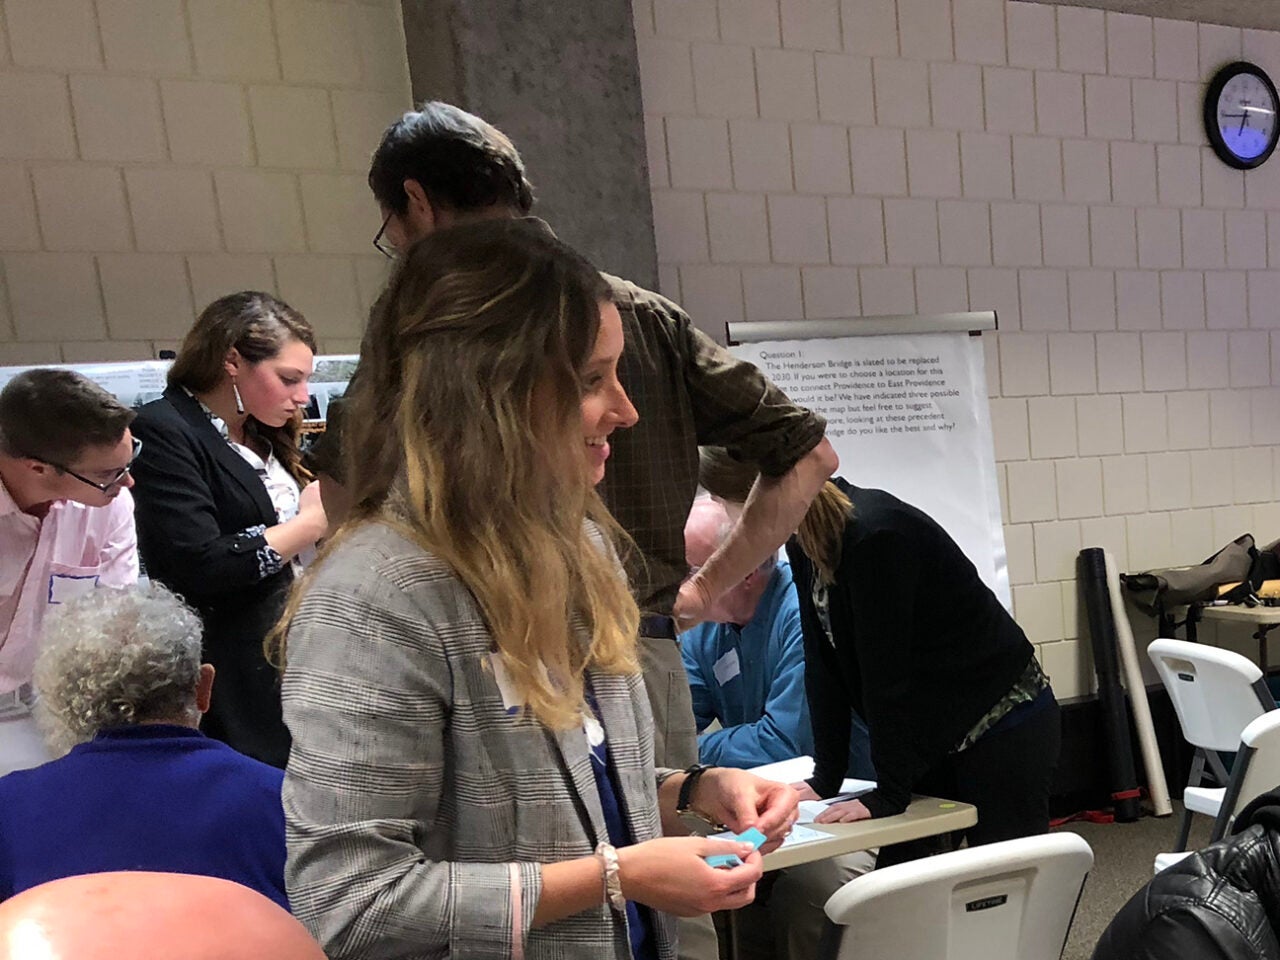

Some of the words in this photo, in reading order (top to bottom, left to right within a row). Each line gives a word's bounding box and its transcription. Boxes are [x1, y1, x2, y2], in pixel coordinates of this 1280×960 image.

[759, 350, 796, 360] Question
[766, 362, 781, 370] The
[783, 361, 826, 370] Henderson
[828, 359, 852, 369] Bridge
[854, 358, 861, 367] is
[862, 357, 885, 366] slated
[886, 357, 895, 366] to
[897, 356, 907, 365] be
[908, 354, 940, 365] replaced
[794, 372, 799, 380] If
[801, 374, 816, 382] you
[849, 370, 877, 378] choose
[885, 368, 915, 377] location
[917, 367, 928, 375] for
[929, 367, 944, 375] this
[800, 384, 832, 392] connect
[833, 381, 875, 390] Providence
[877, 380, 886, 388] to
[887, 379, 903, 388] East
[905, 378, 946, 388] Providence
[792, 395, 815, 403] would
[838, 393, 852, 401] We
[853, 391, 872, 400] have
[873, 390, 907, 400] indicated
[908, 390, 928, 399] three
[929, 388, 960, 398] possible
[814, 405, 827, 413] the
[829, 406, 846, 414] map
[847, 404, 861, 412] but
[862, 403, 876, 411] feel
[878, 402, 893, 411] free
[895, 402, 904, 410] to
[905, 402, 932, 411] suggest
[846, 415, 874, 425] looking
[876, 413, 884, 422] at
[885, 412, 906, 422] these
[907, 411, 945, 422] precedent
[825, 428, 845, 438] ridge
[847, 427, 857, 436] do
[859, 428, 874, 438] you
[875, 426, 888, 435] like
[890, 424, 904, 434] the
[904, 424, 920, 433] best
[922, 423, 936, 432] and
[938, 421, 956, 433] why?
